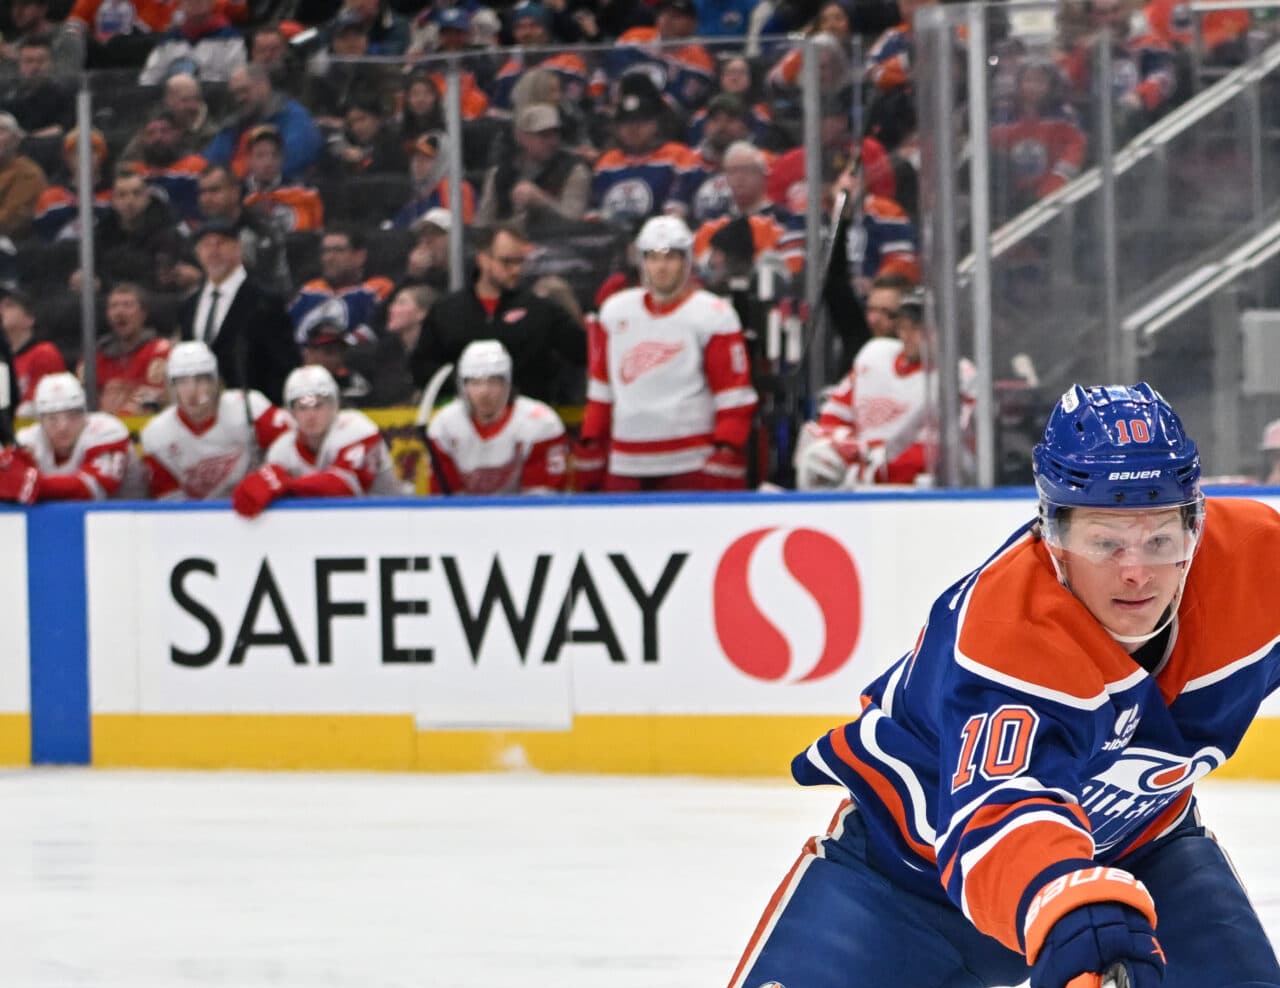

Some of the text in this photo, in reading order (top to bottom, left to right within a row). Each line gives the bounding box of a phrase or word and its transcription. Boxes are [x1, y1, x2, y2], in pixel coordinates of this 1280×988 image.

[1115, 419, 1150, 444] 10
[1108, 470, 1161, 481] BAUER
[168, 552, 691, 668] SAFEWAY
[950, 704, 1040, 796] 10
